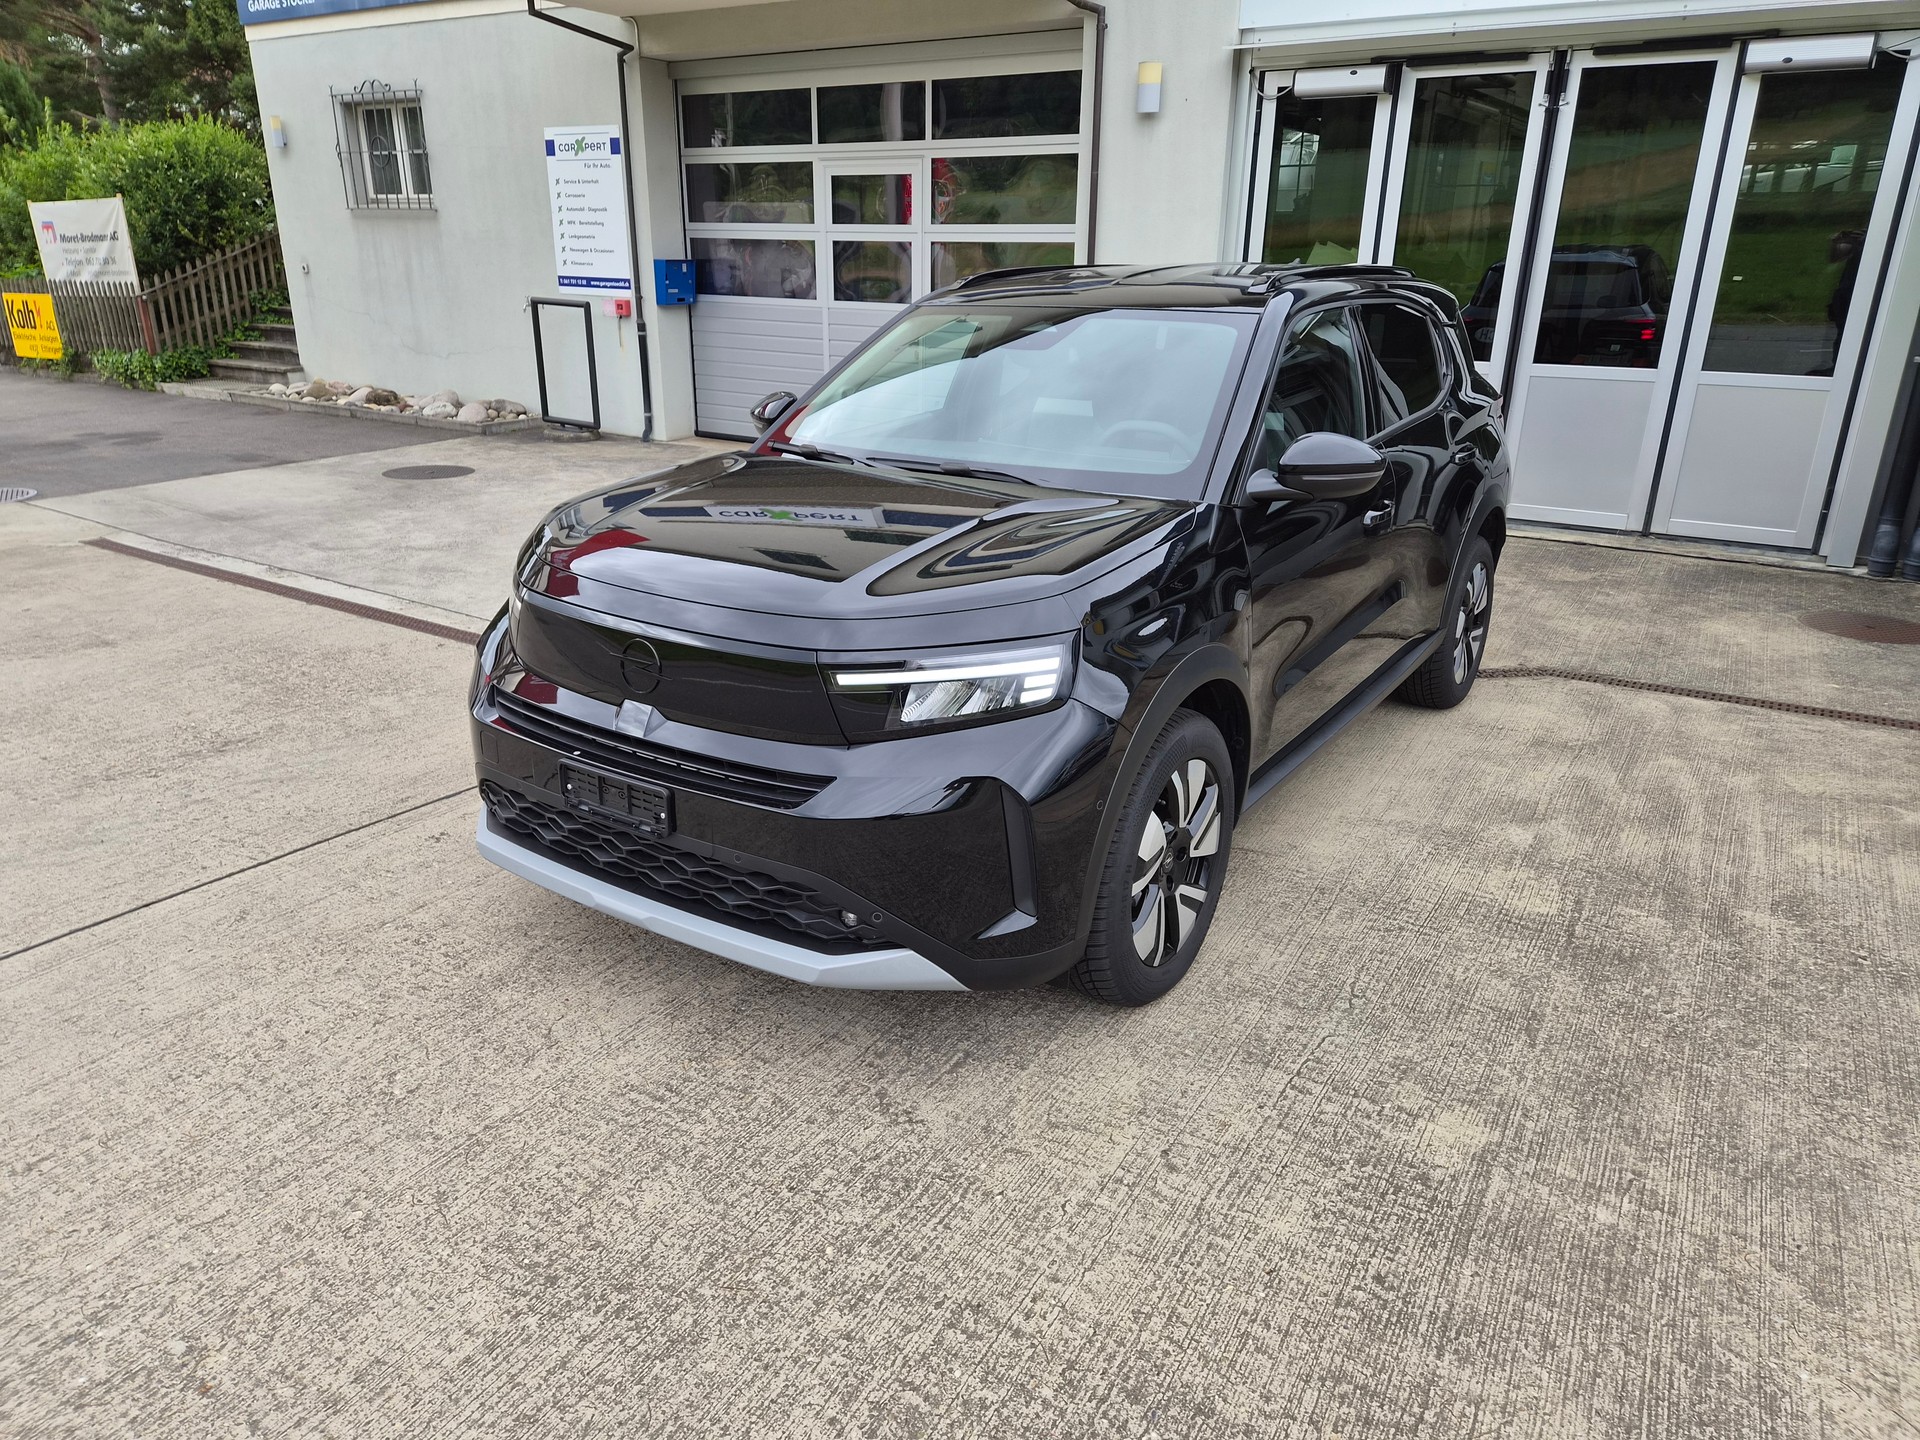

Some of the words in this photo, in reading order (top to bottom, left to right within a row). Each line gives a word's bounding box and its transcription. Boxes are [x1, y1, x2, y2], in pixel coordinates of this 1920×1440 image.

[248, 0, 281, 12] GARAGE
[109, 230, 119, 242] AG
[5, 299, 37, 330] Kolb
